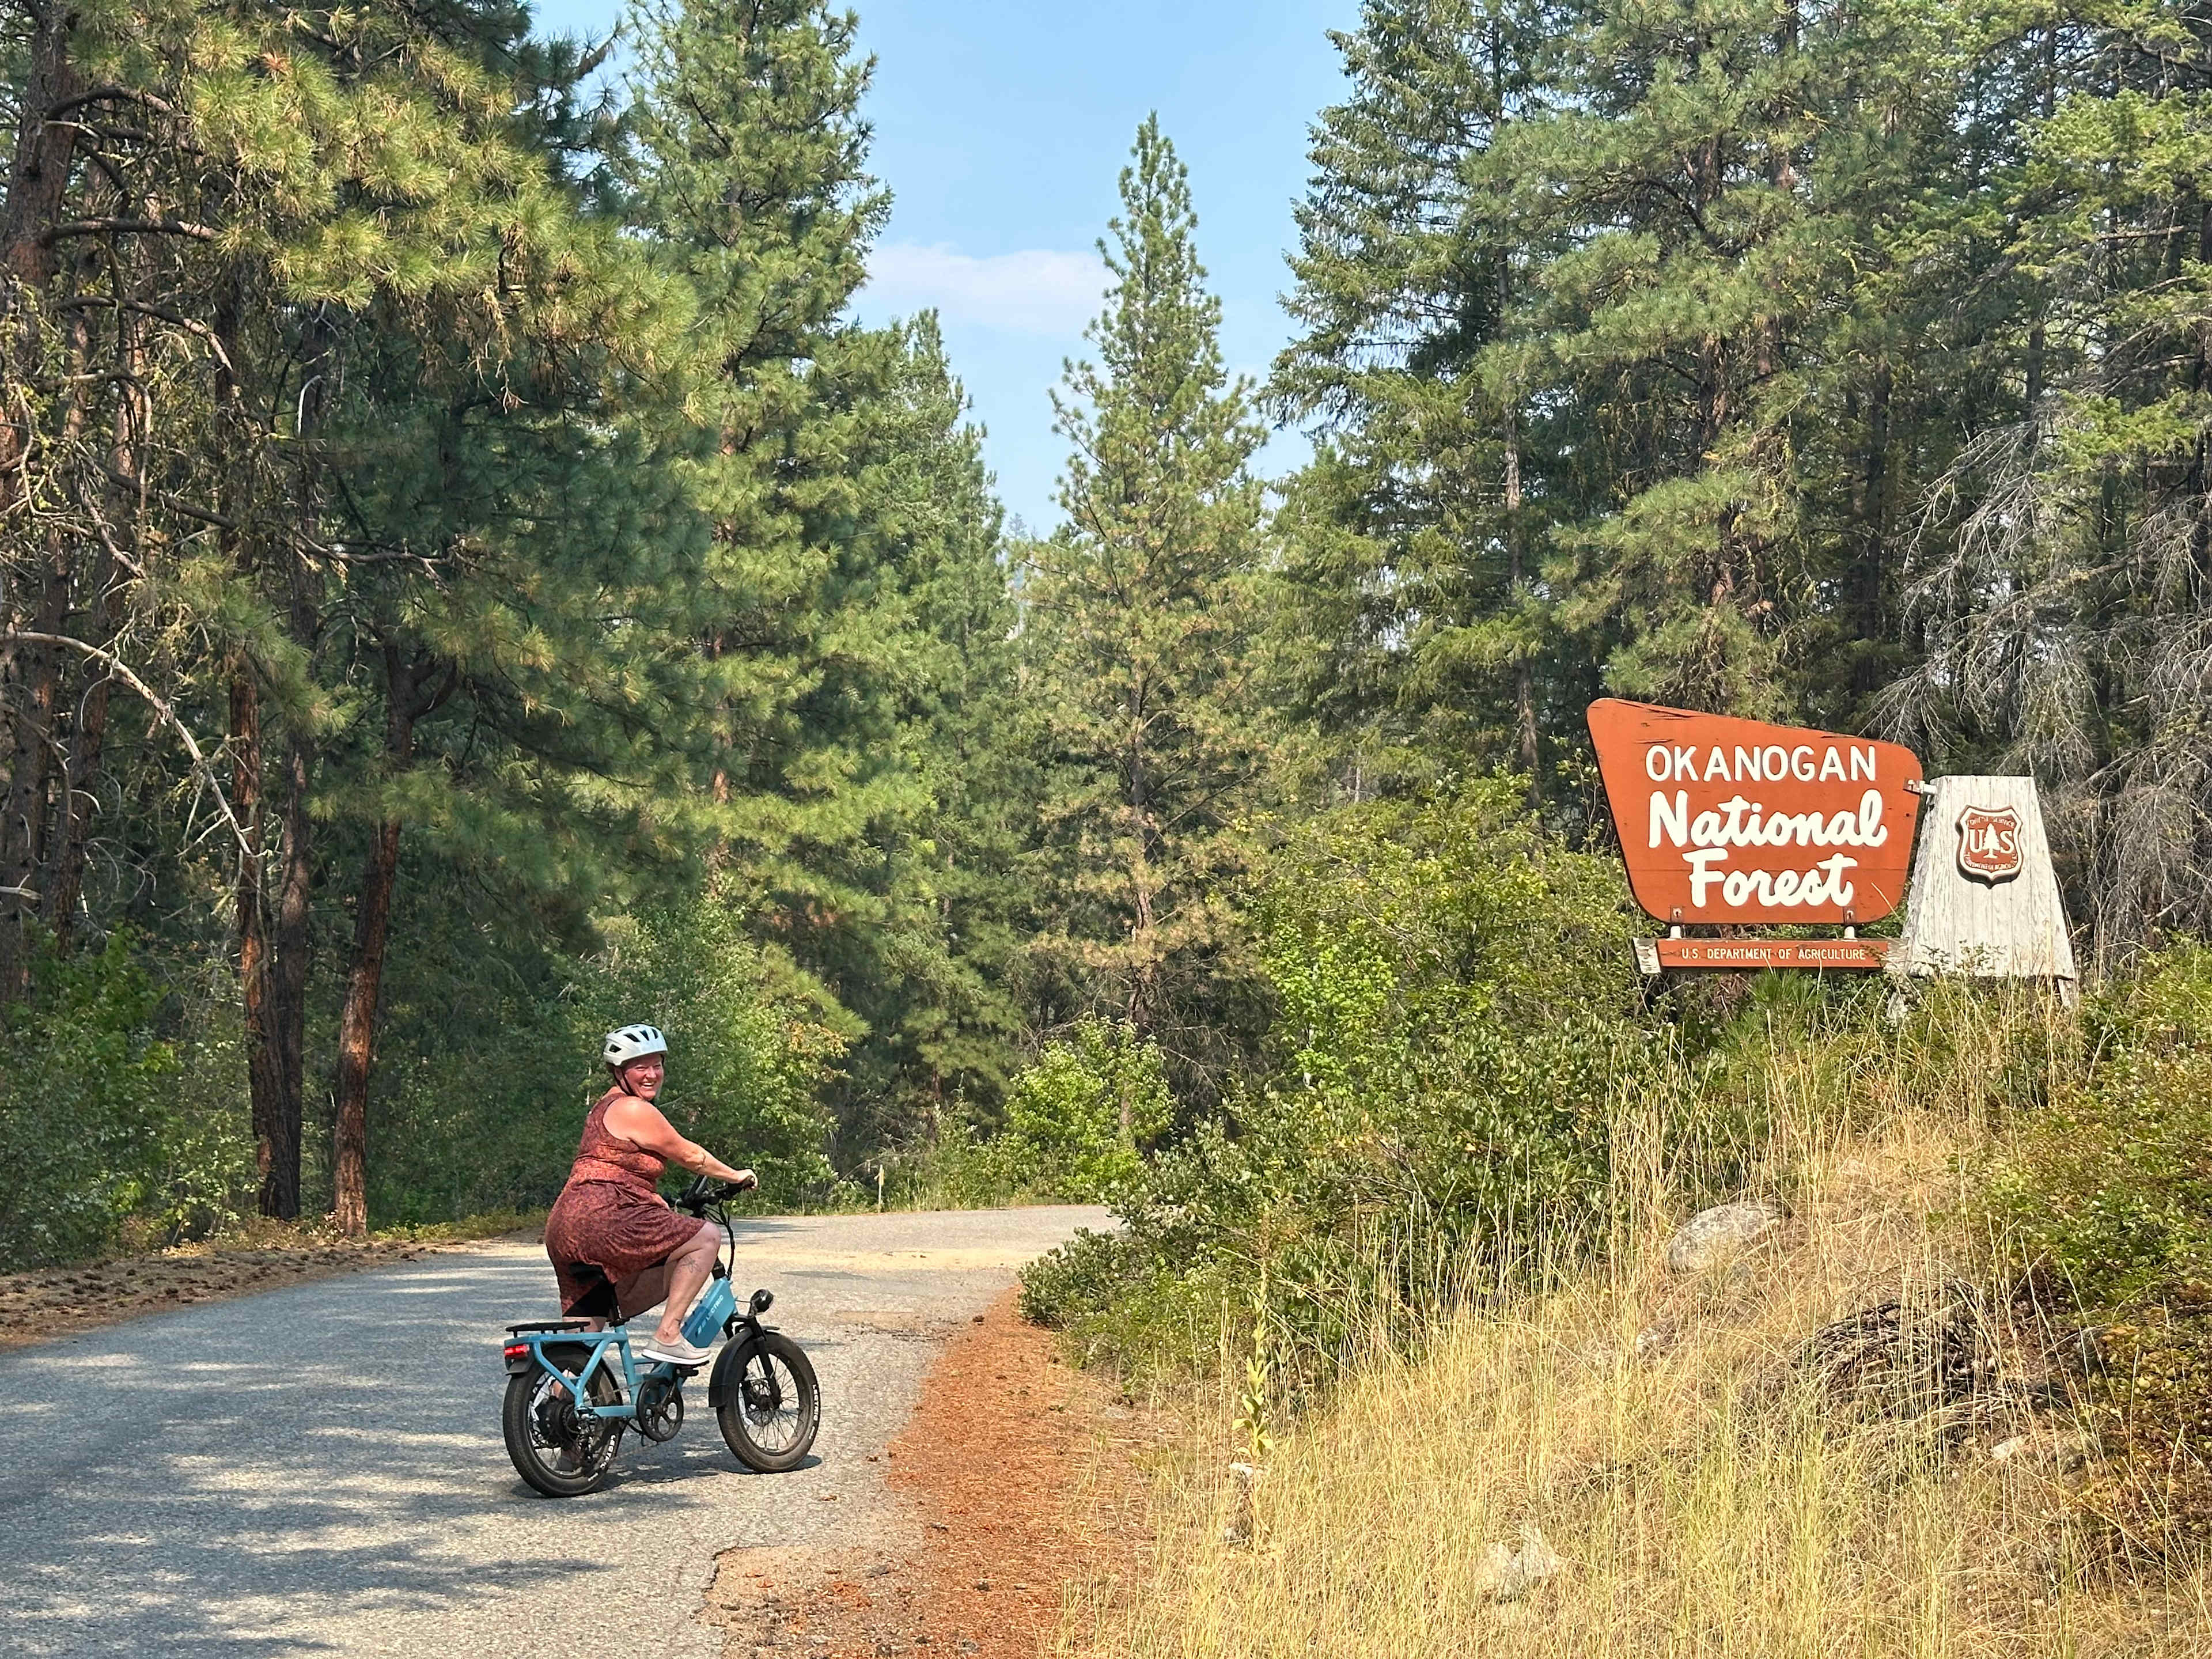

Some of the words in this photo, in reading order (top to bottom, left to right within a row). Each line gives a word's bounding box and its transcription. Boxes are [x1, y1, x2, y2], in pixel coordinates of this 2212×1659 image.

[1645, 744, 1876, 782] OKANOGAN
[1648, 789, 1888, 849] National
[1681, 847, 1858, 908] Forest
[1681, 948, 1701, 960] U.S.
[1707, 948, 1772, 960] DEPARTMENT
[1778, 948, 1792, 960] OF
[1798, 948, 1866, 960] AGRICULTURE
